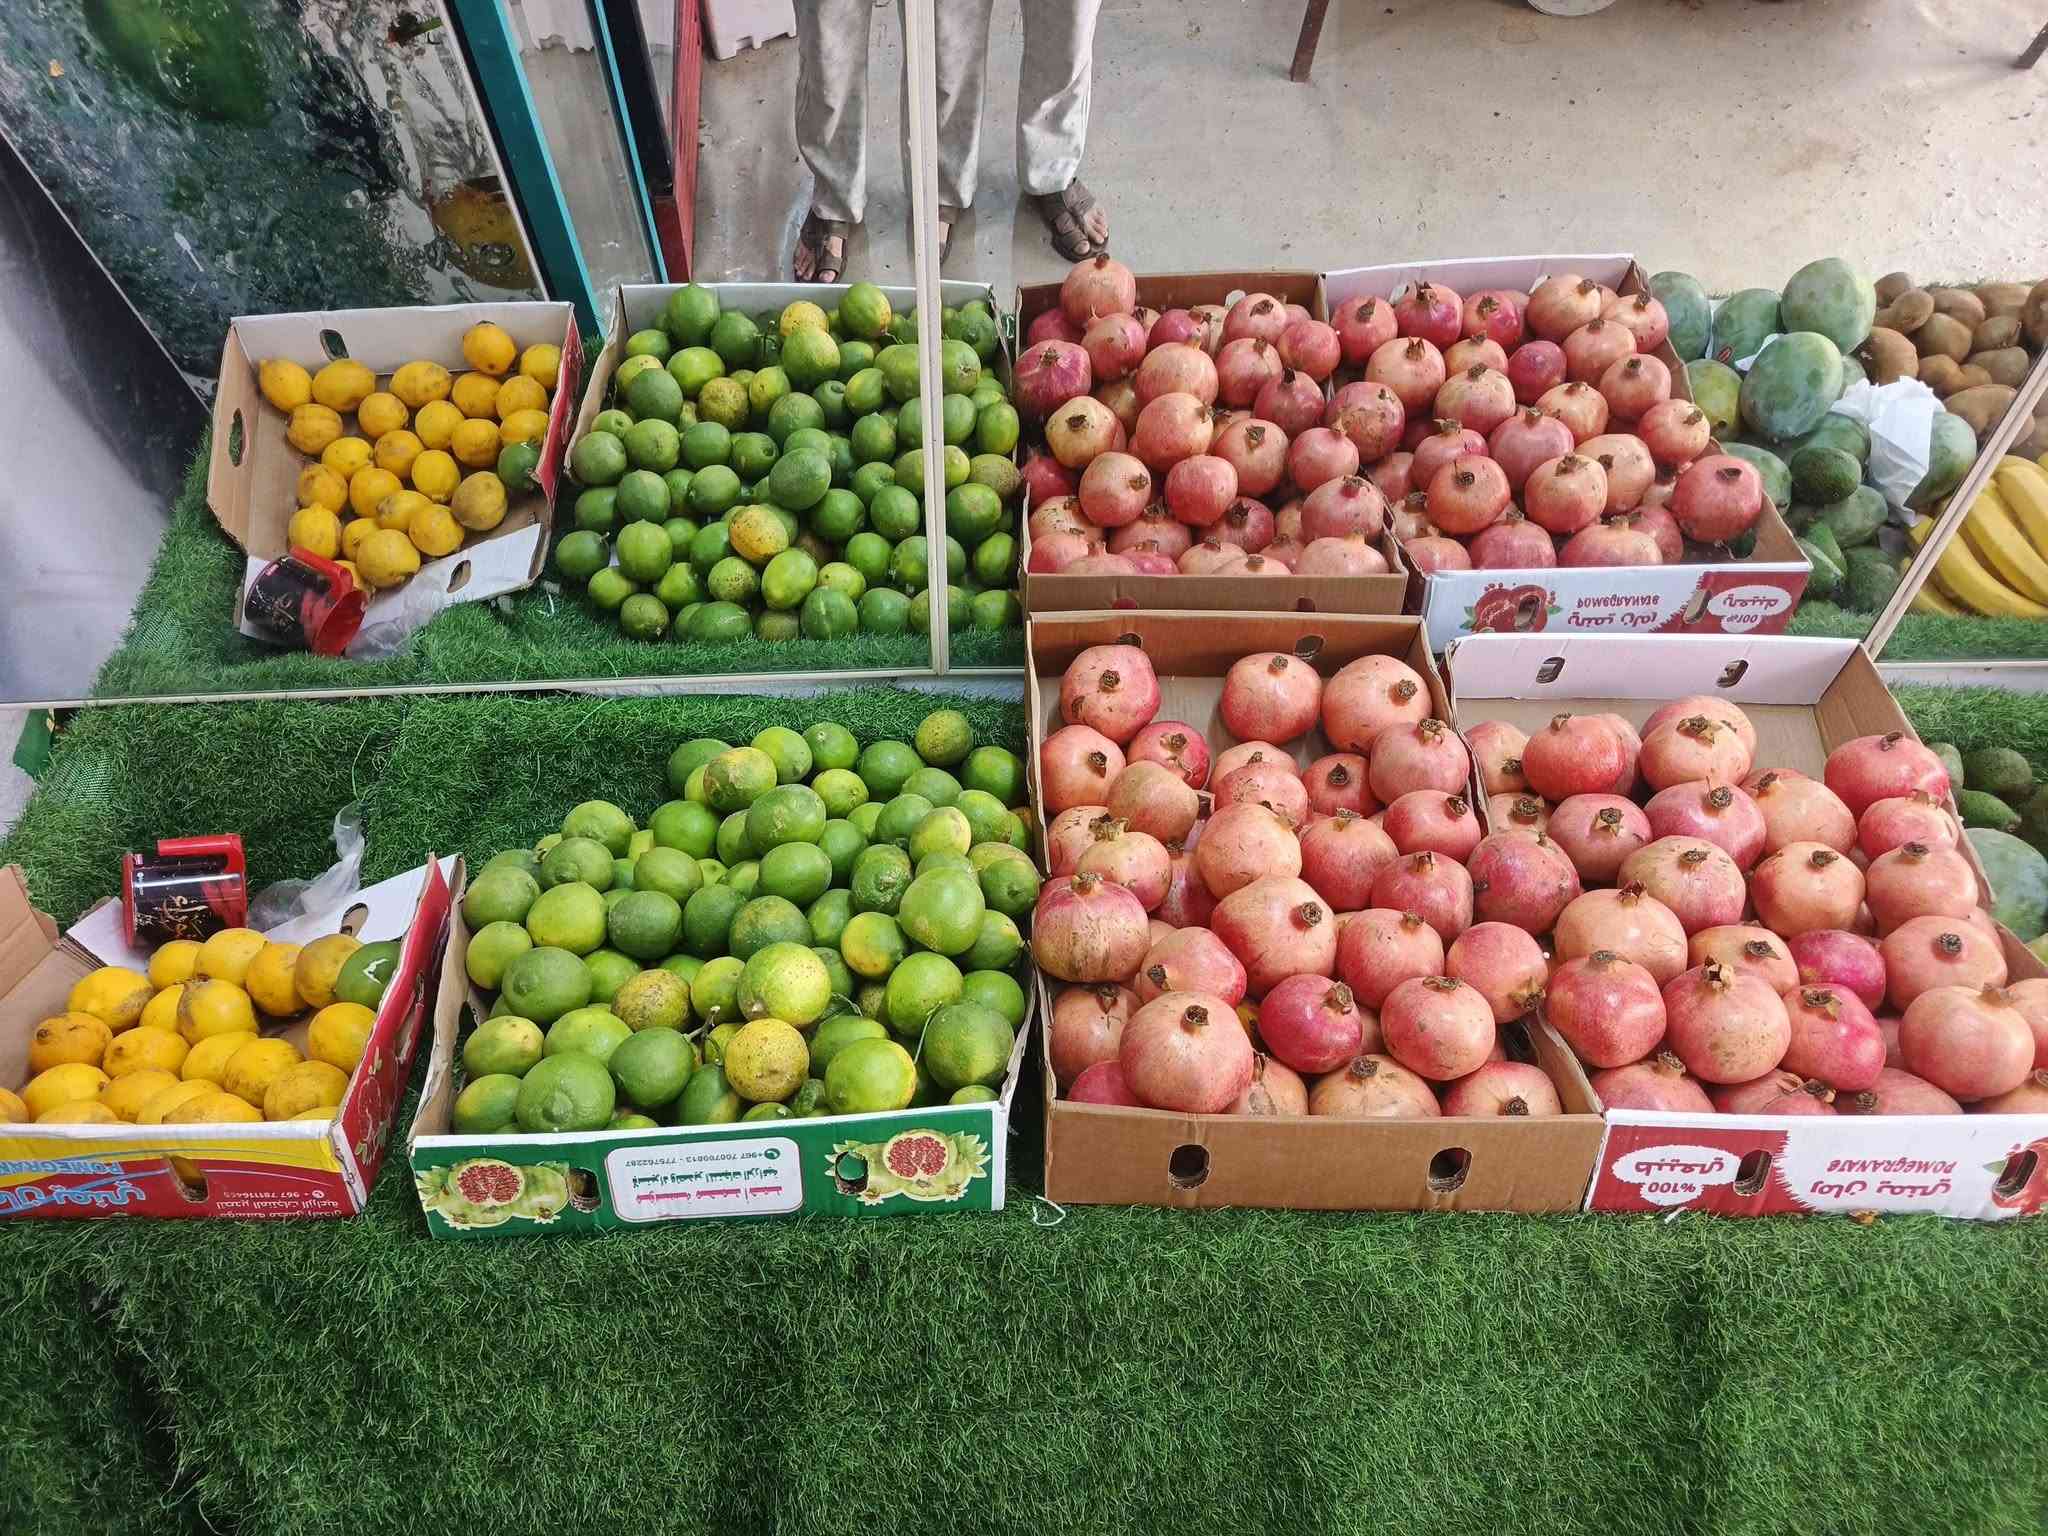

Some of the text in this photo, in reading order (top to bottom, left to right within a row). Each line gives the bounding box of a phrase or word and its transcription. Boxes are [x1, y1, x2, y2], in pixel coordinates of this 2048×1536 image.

[1635, 1157, 1724, 1176] طبيعي
[1826, 1157, 1958, 1174] POMEGRANATE
[48, 1180, 146, 1208] يمني
[1810, 1179, 1952, 1198] رمان يمني
